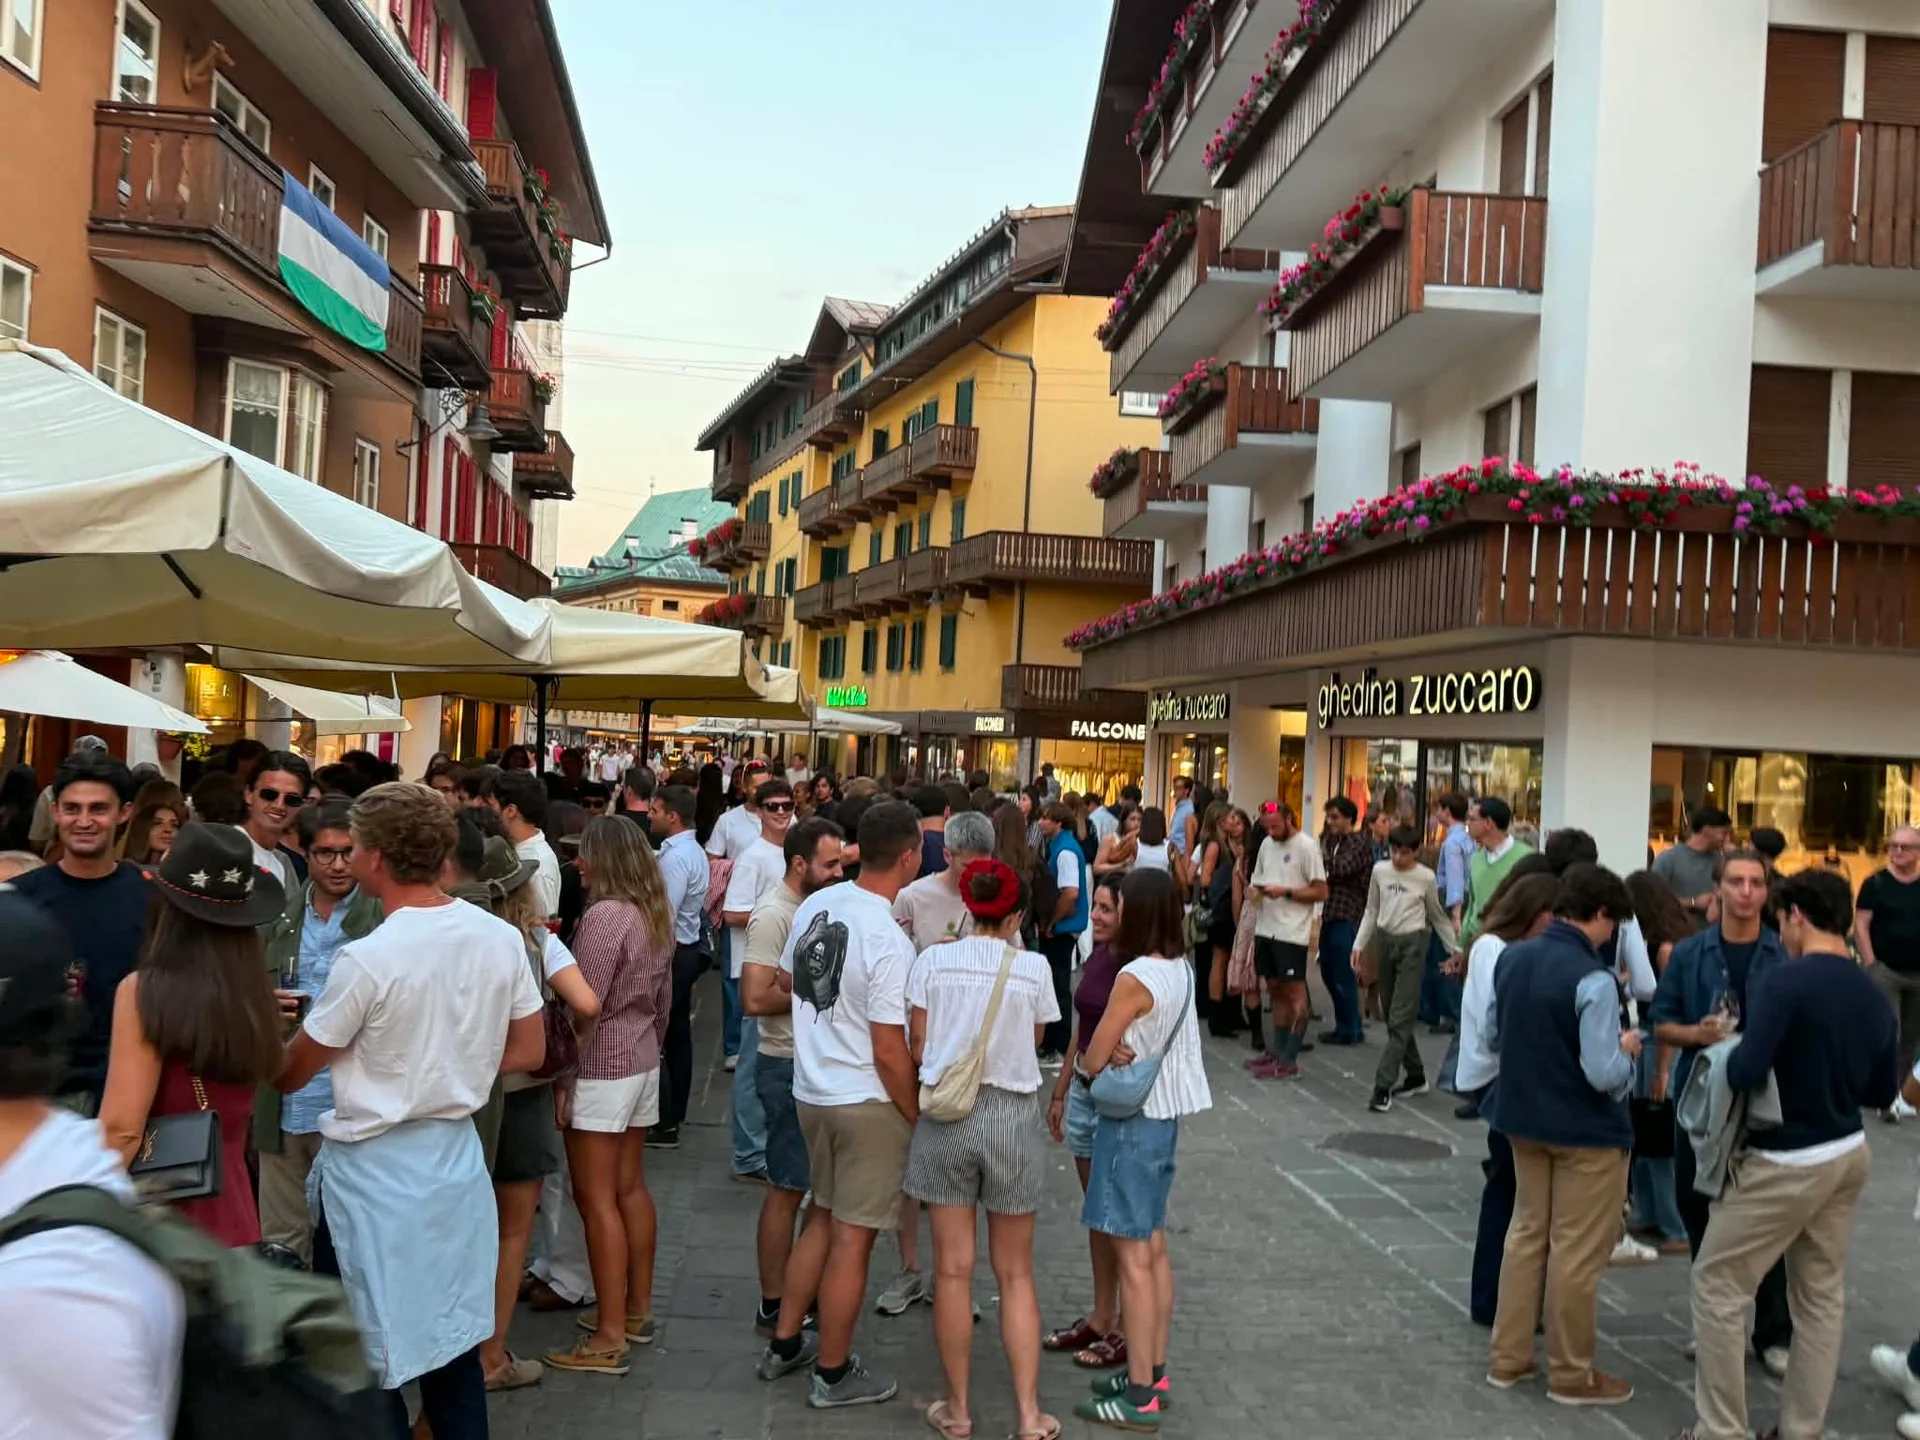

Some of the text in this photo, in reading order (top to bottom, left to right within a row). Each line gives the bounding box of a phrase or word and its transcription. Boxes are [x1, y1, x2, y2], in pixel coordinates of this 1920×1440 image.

[1150, 689, 1227, 730] ghedina zuccaro
[1318, 665, 1533, 729] ghedina zuccaro
